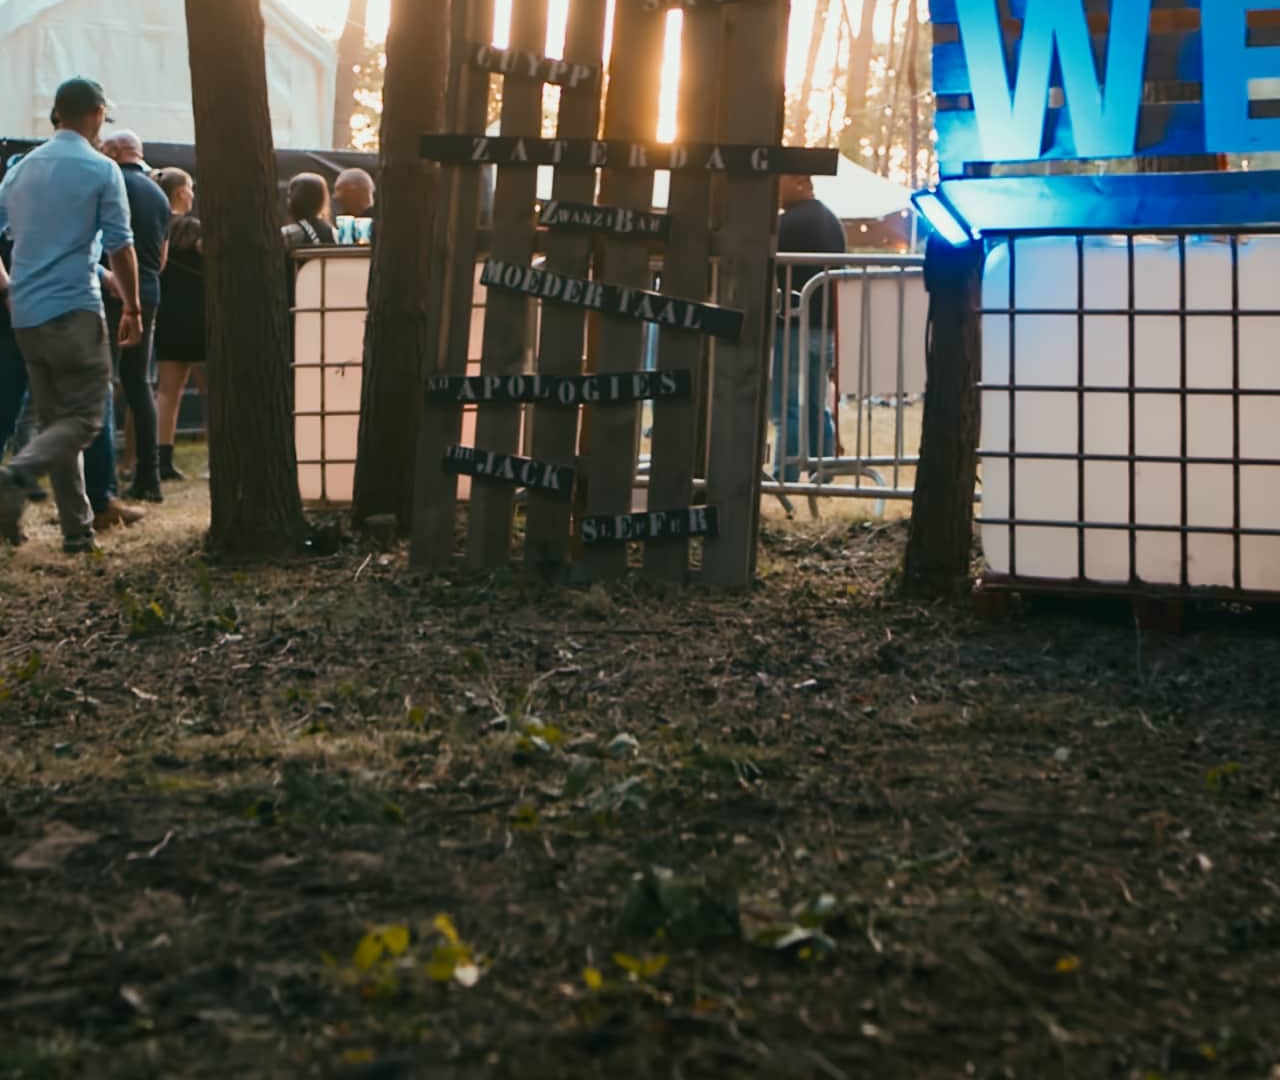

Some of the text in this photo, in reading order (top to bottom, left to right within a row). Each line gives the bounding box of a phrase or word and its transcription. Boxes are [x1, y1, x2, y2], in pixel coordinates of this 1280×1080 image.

[471, 137, 770, 170] ZATERDAG
[481, 259, 702, 330] MOEDER TAAL
[457, 371, 677, 405] APOLOGIES
[476, 451, 560, 489] JACK
